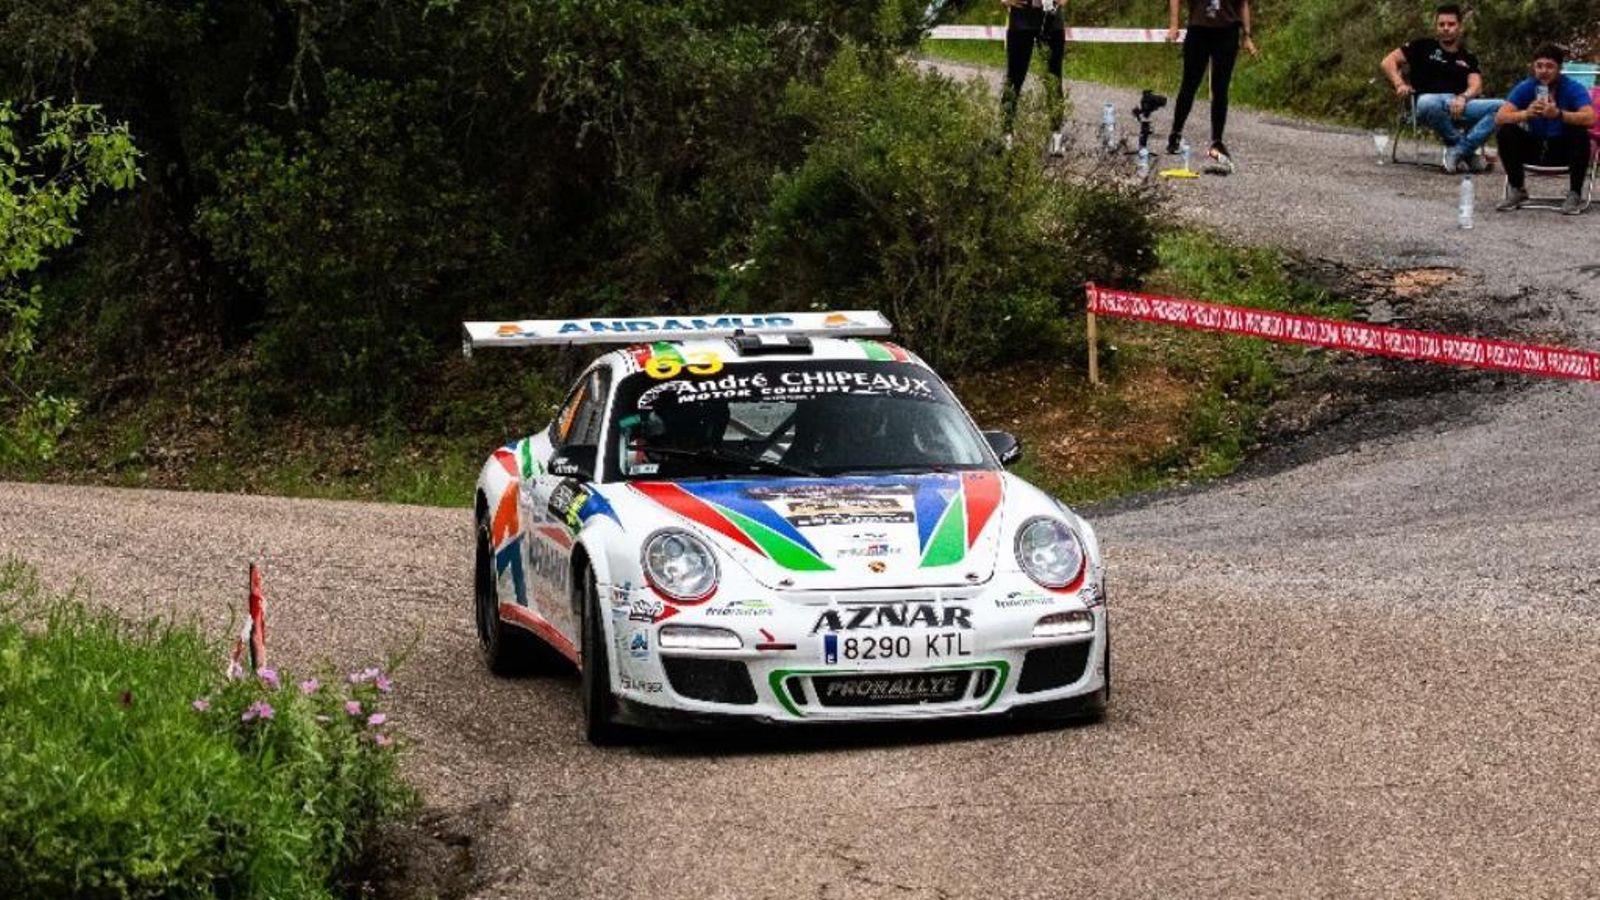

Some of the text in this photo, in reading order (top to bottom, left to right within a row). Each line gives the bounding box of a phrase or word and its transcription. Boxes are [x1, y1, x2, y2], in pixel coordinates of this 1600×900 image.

[645, 350, 724, 379] 63
[677, 373, 768, 395] André
[780, 371, 932, 394] CHIPEAUX
[677, 389, 752, 404] MOTOR
[811, 603, 973, 635] AZNAR
[843, 634, 911, 660] 8290
[925, 632, 971, 658] KTL
[826, 675, 958, 696] PRORALLYE
